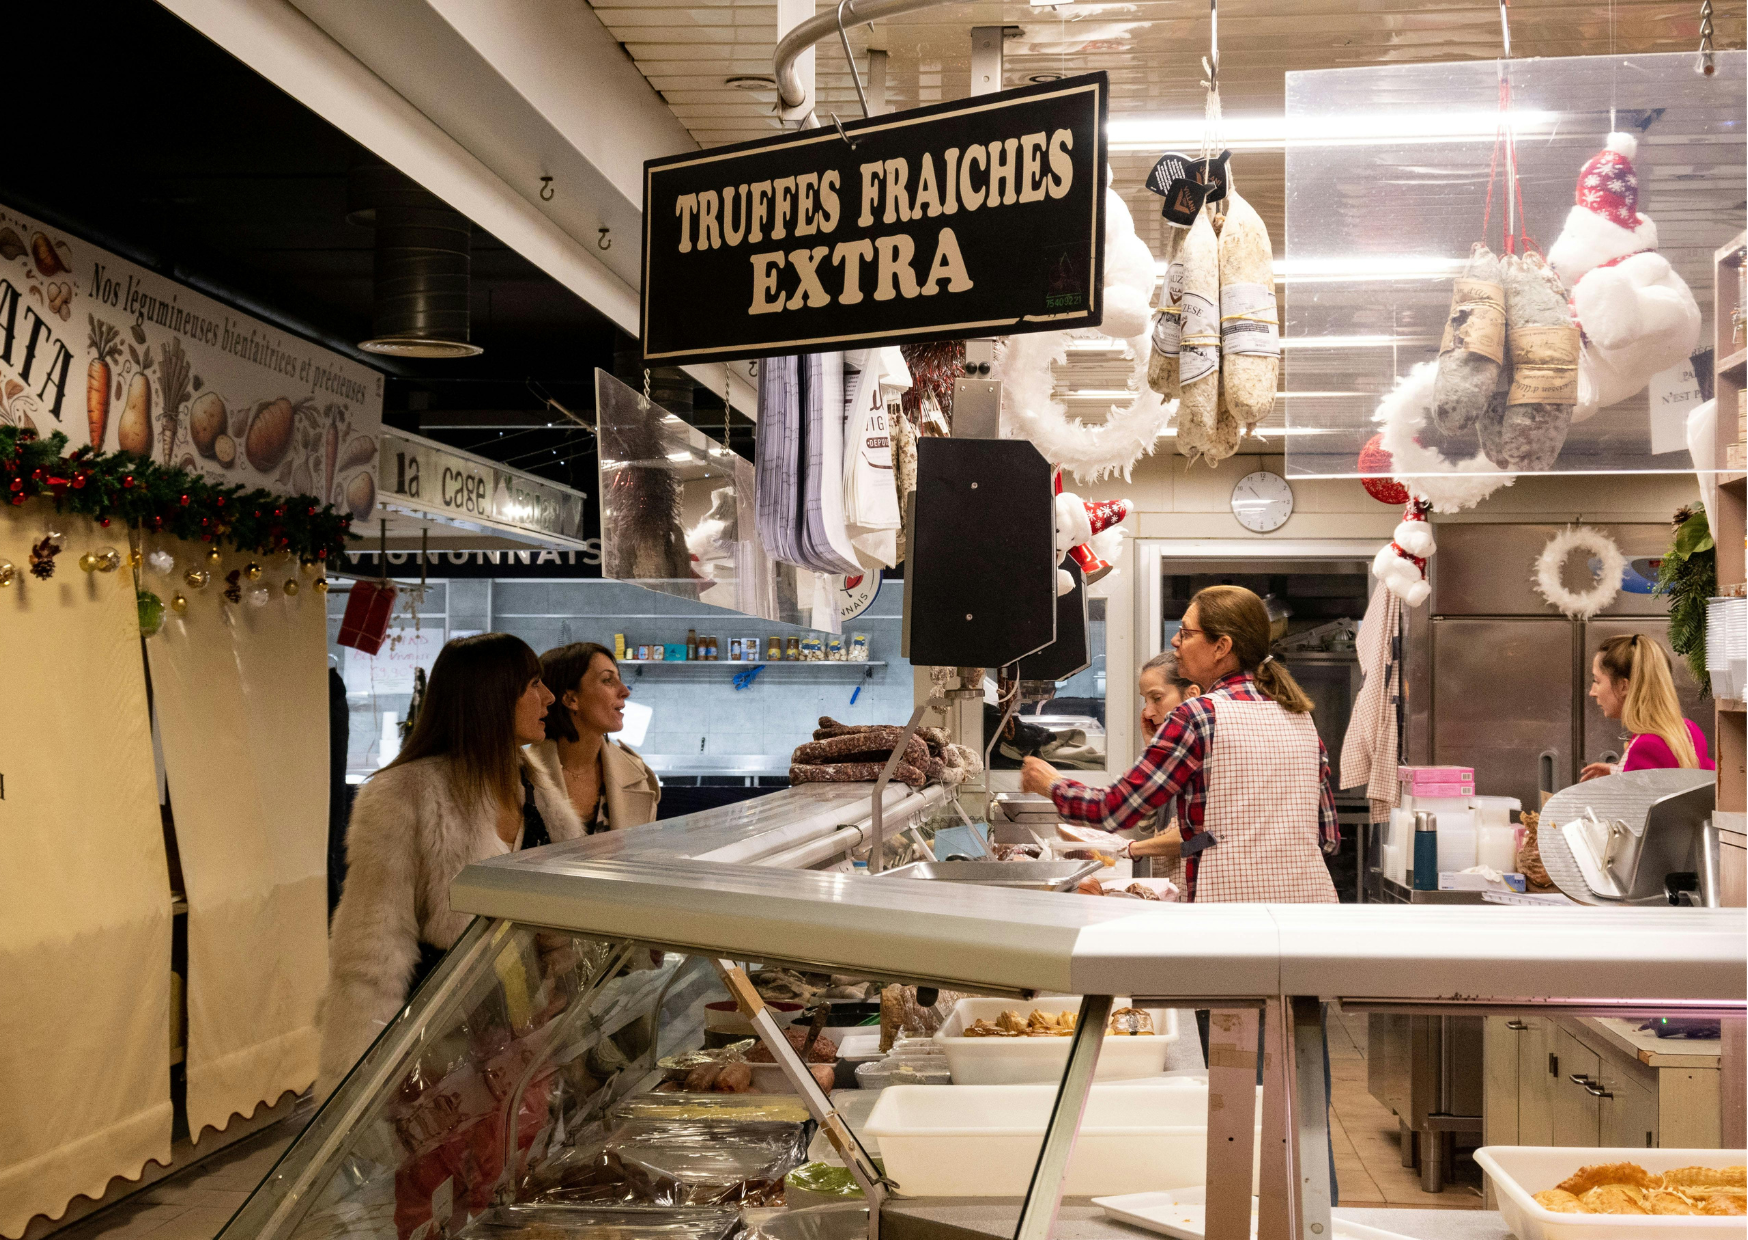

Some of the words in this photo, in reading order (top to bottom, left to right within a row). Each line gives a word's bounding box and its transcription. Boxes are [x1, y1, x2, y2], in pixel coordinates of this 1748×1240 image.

[675, 169, 841, 254] TRUFFES
[857, 129, 1074, 227] FRAICHES
[1183, 185, 1196, 213] VILLANI
[748, 227, 974, 315] EXTRA
[88, 262, 121, 307] Nos
[123, 275, 219, 347] légumineuses
[221, 316, 298, 378] bienfaitrices
[300, 357, 312, 384] et
[311, 361, 367, 405] précieuses
[1662, 391, 1691, 405] N'EST
[394, 452, 420, 499] la
[441, 466, 486, 515] cage
